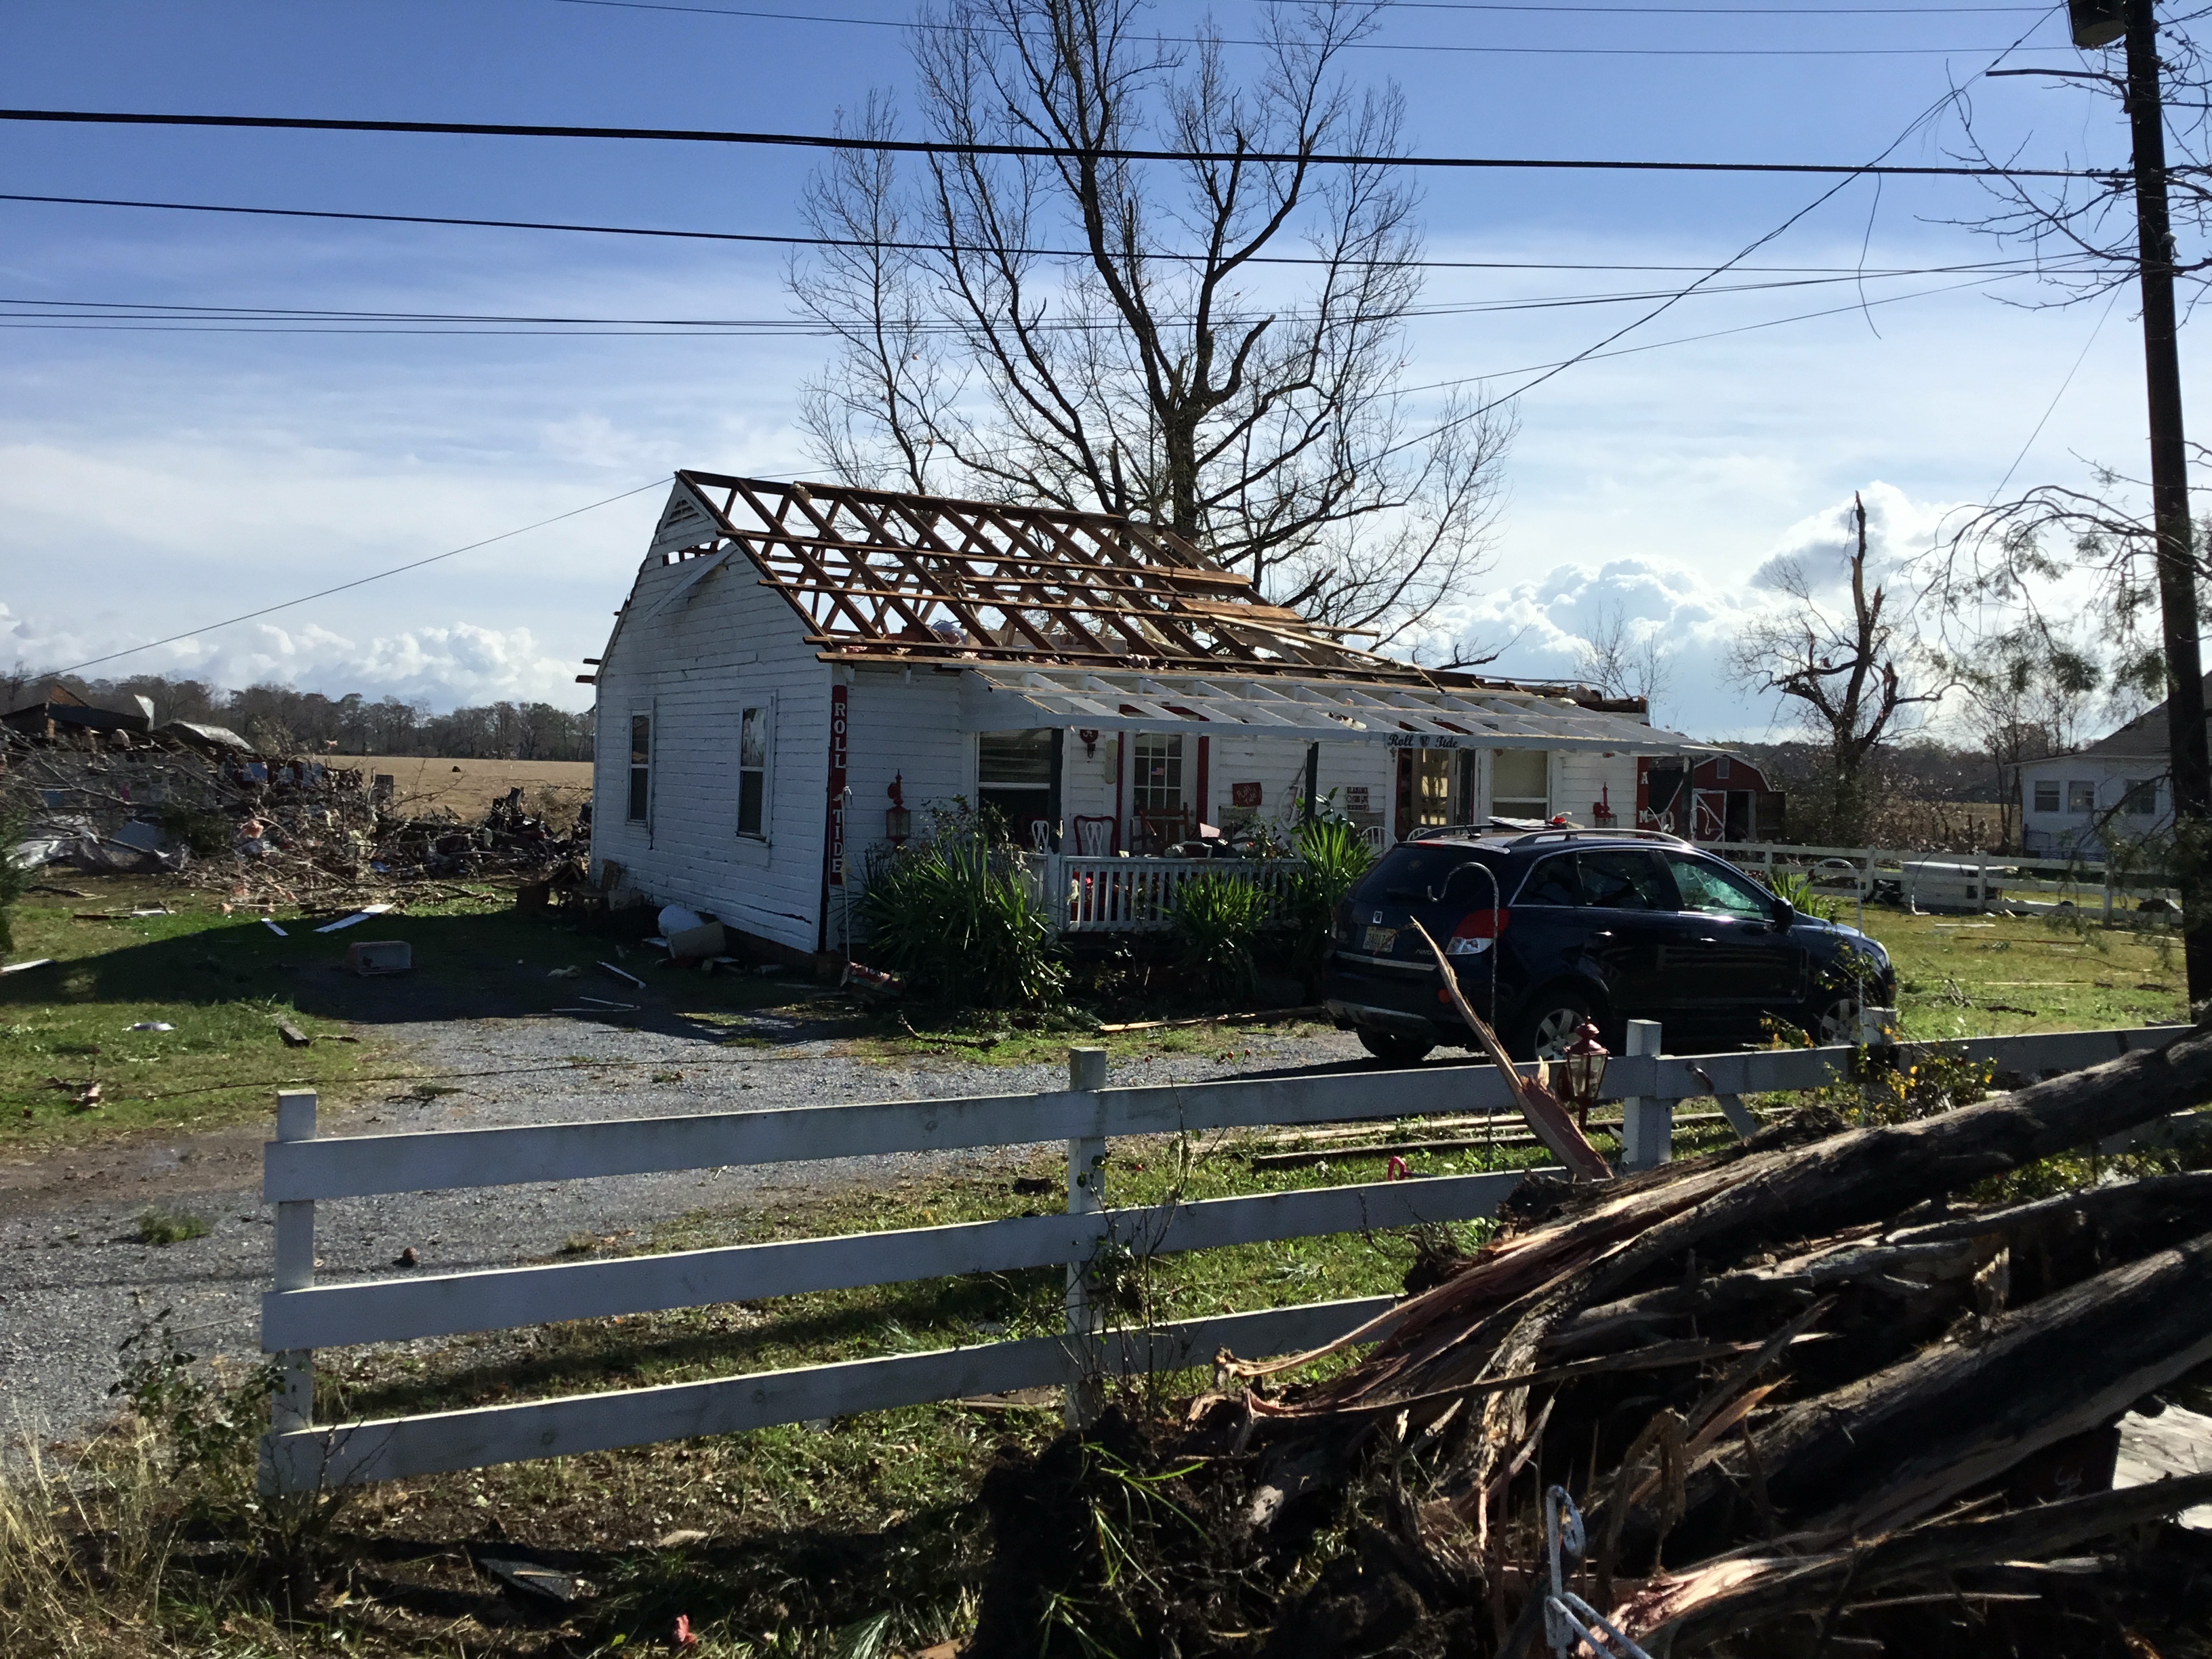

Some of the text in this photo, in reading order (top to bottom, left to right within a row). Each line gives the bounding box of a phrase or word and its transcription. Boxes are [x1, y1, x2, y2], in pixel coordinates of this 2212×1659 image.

[1387, 734, 1458, 748] Roll Tide
[832, 702, 846, 873] ROLL TIDE
